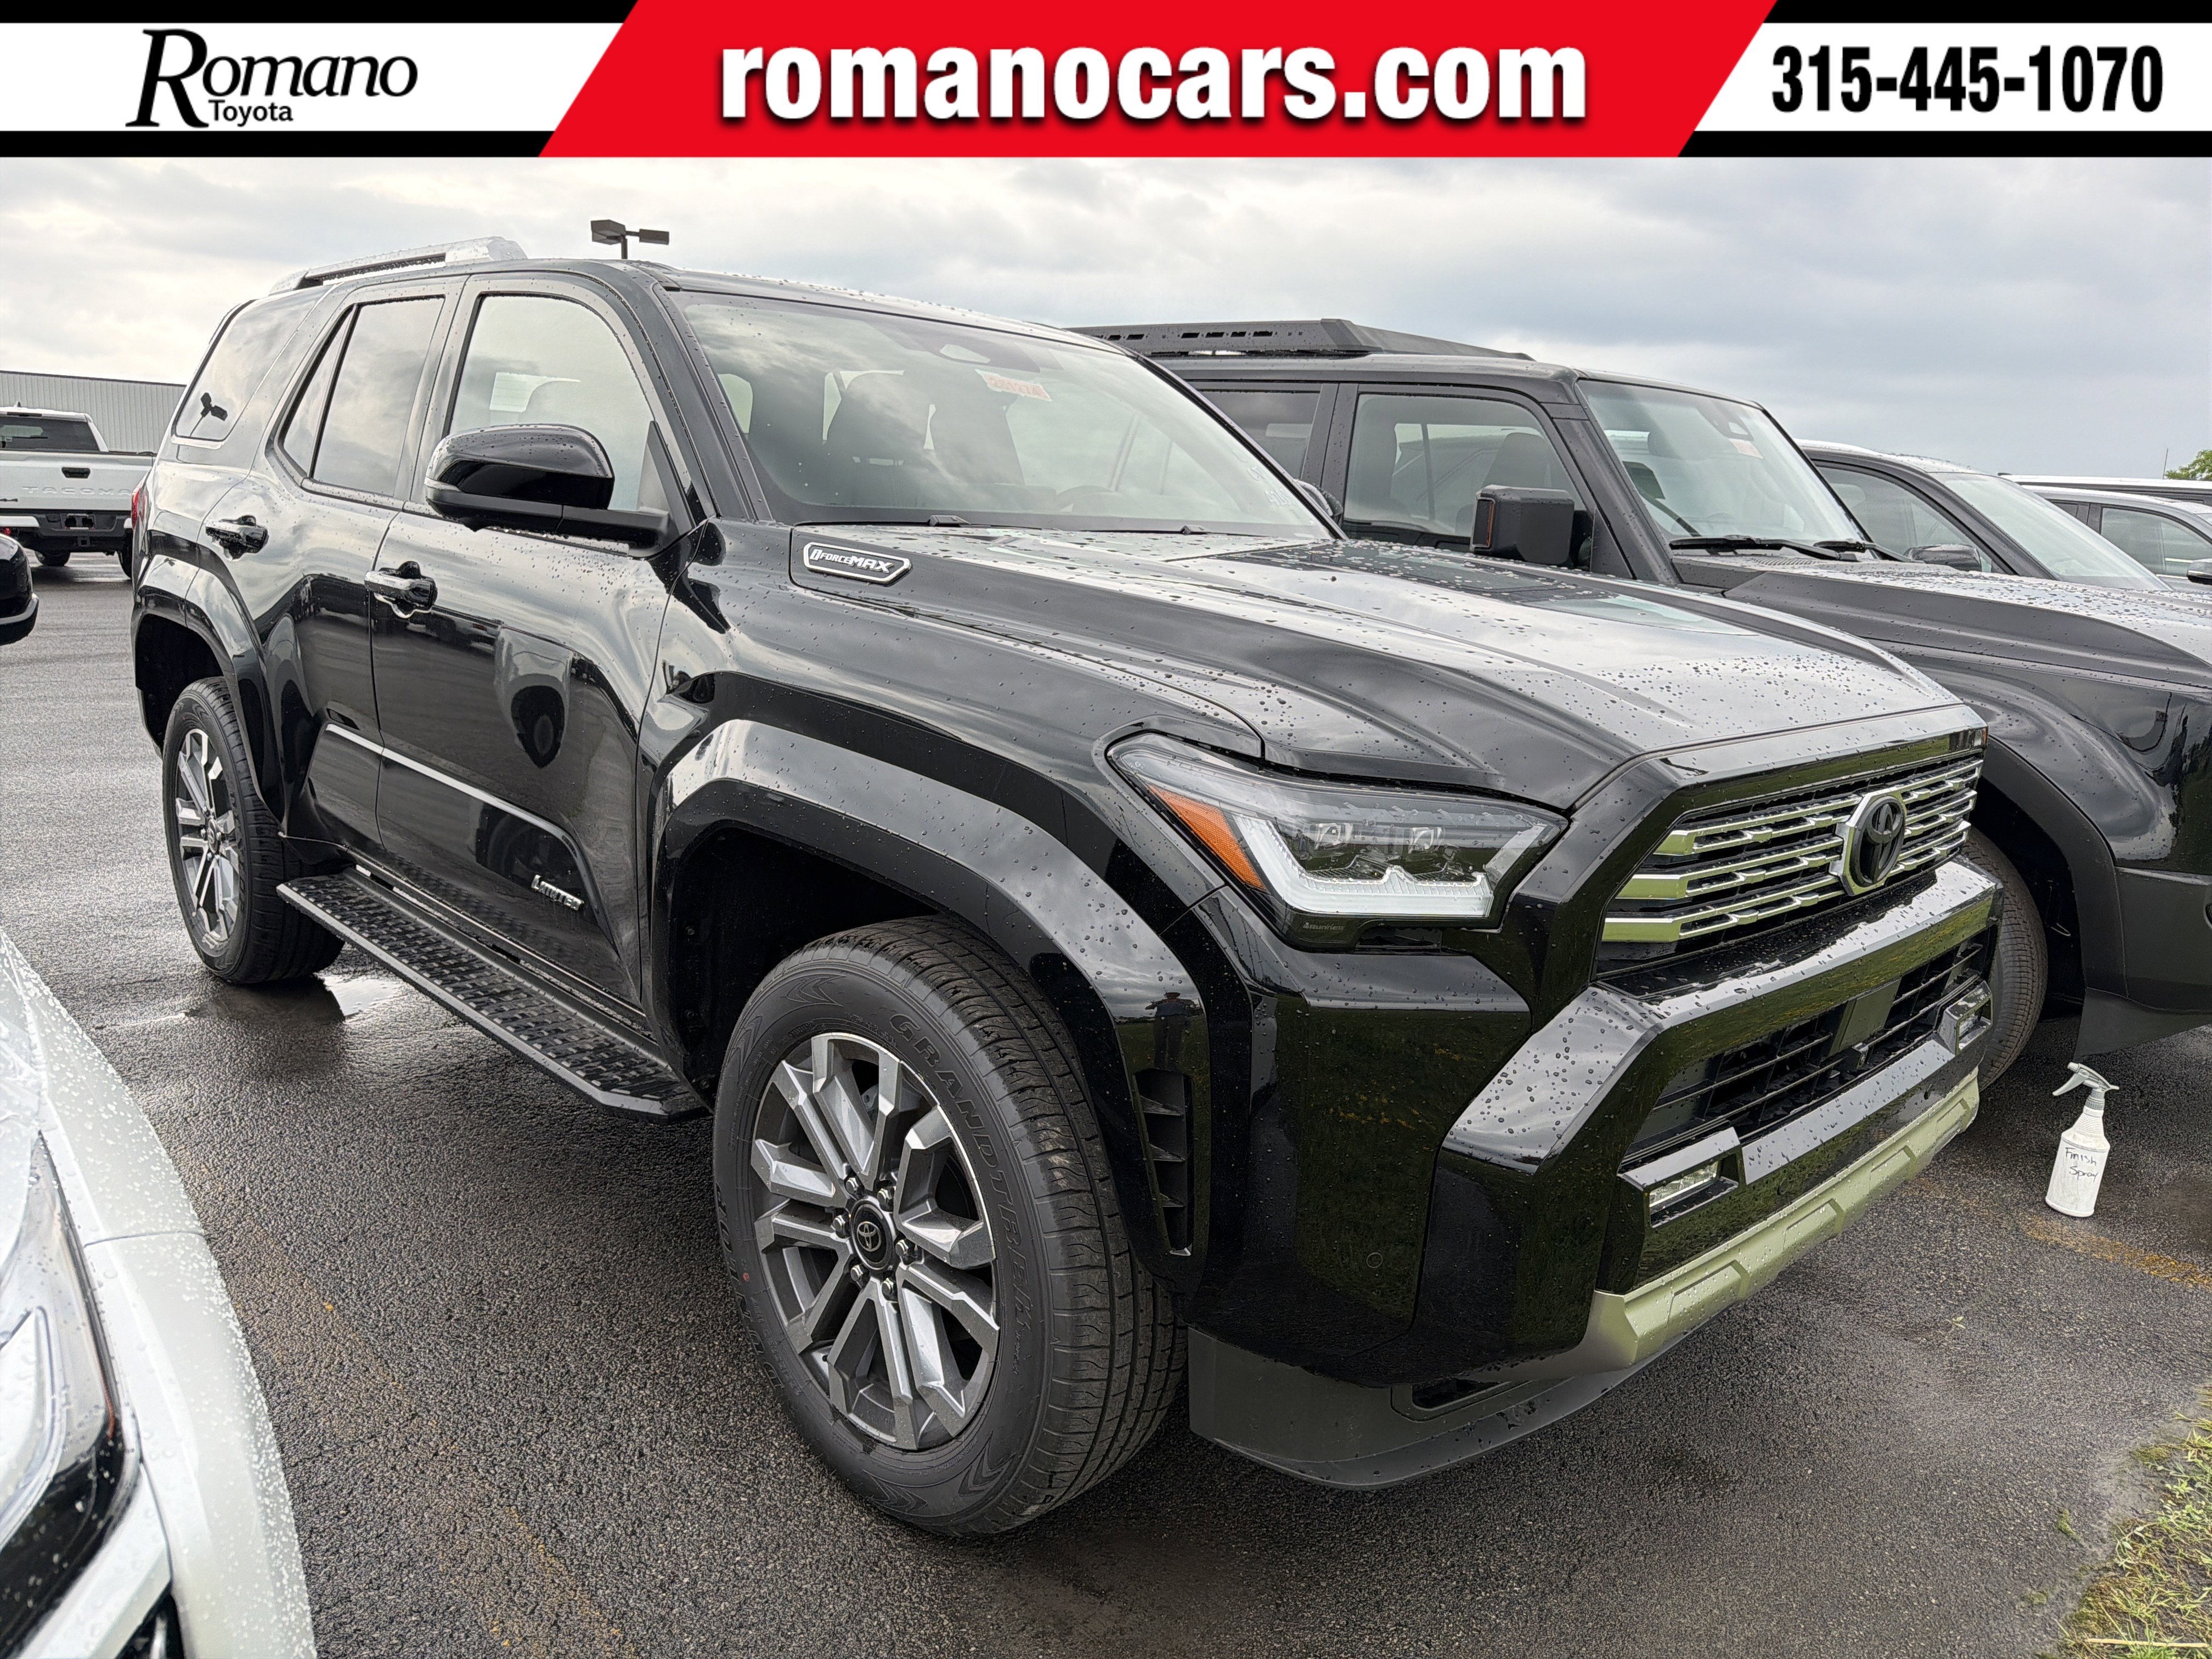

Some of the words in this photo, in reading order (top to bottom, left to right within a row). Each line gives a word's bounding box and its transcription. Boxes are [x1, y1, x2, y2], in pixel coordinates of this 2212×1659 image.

[22, 486, 132, 495] TACOMA
[2065, 1147, 2097, 1166] Finish
[889, 1014, 1034, 1330] GRANDTREK
[2069, 1166, 2099, 1183] Spray
[715, 1181, 785, 1390] DUNLOP
